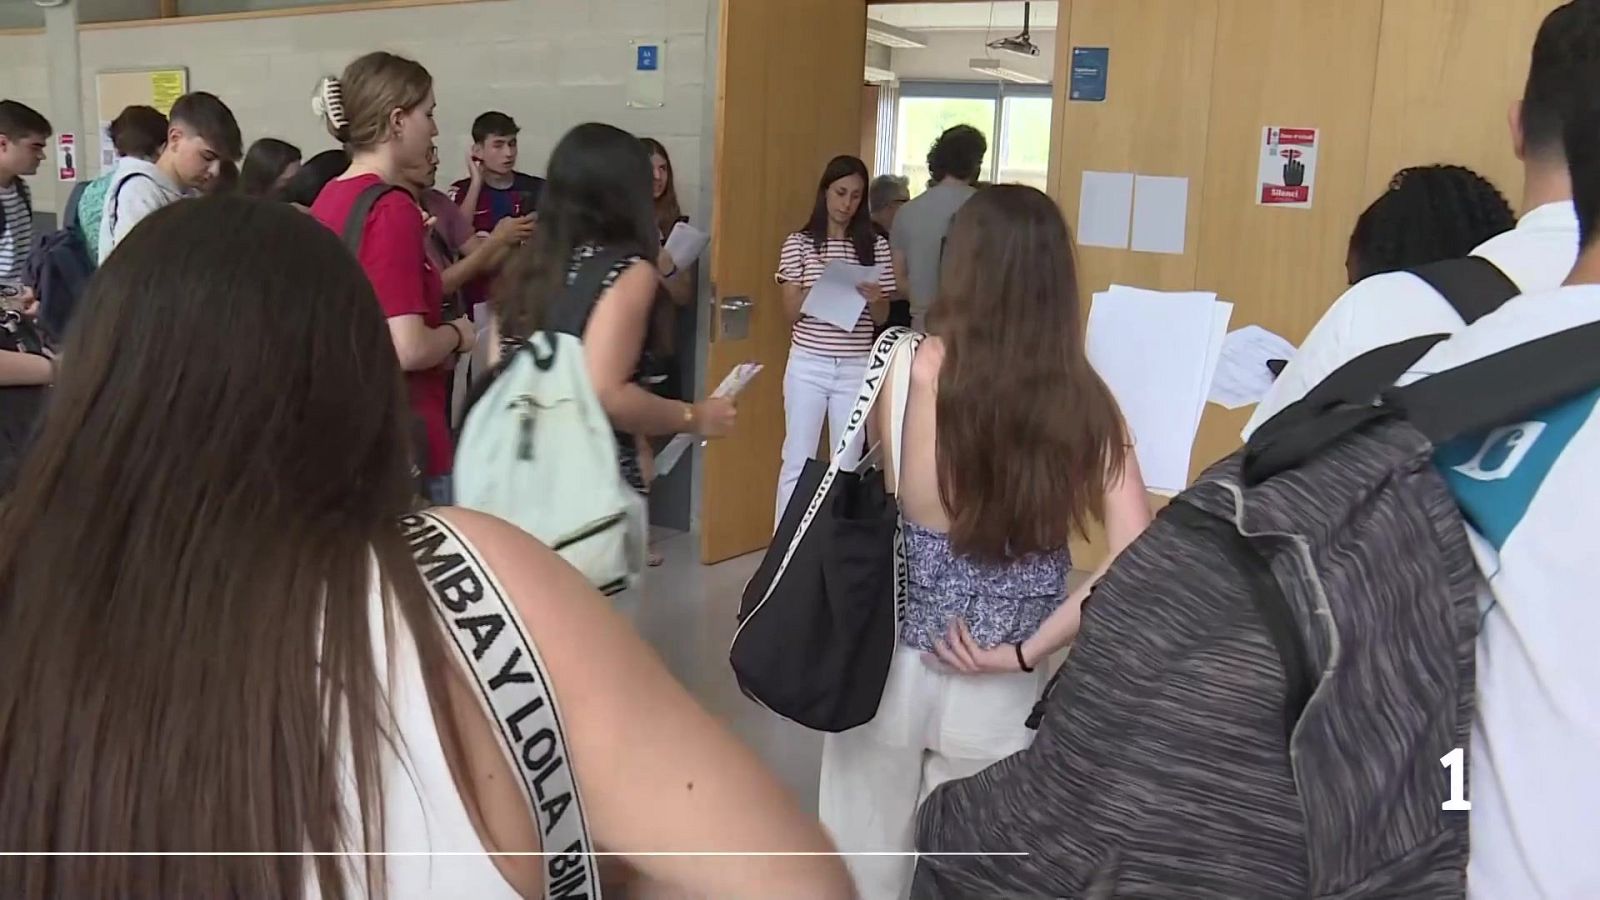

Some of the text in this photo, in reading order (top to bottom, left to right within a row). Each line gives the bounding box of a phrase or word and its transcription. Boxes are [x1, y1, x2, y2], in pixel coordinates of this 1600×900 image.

[1271, 188, 1299, 198] Silenci
[865, 375, 880, 391] Y
[488, 647, 535, 692] Y
[505, 697, 572, 836] LOLA
